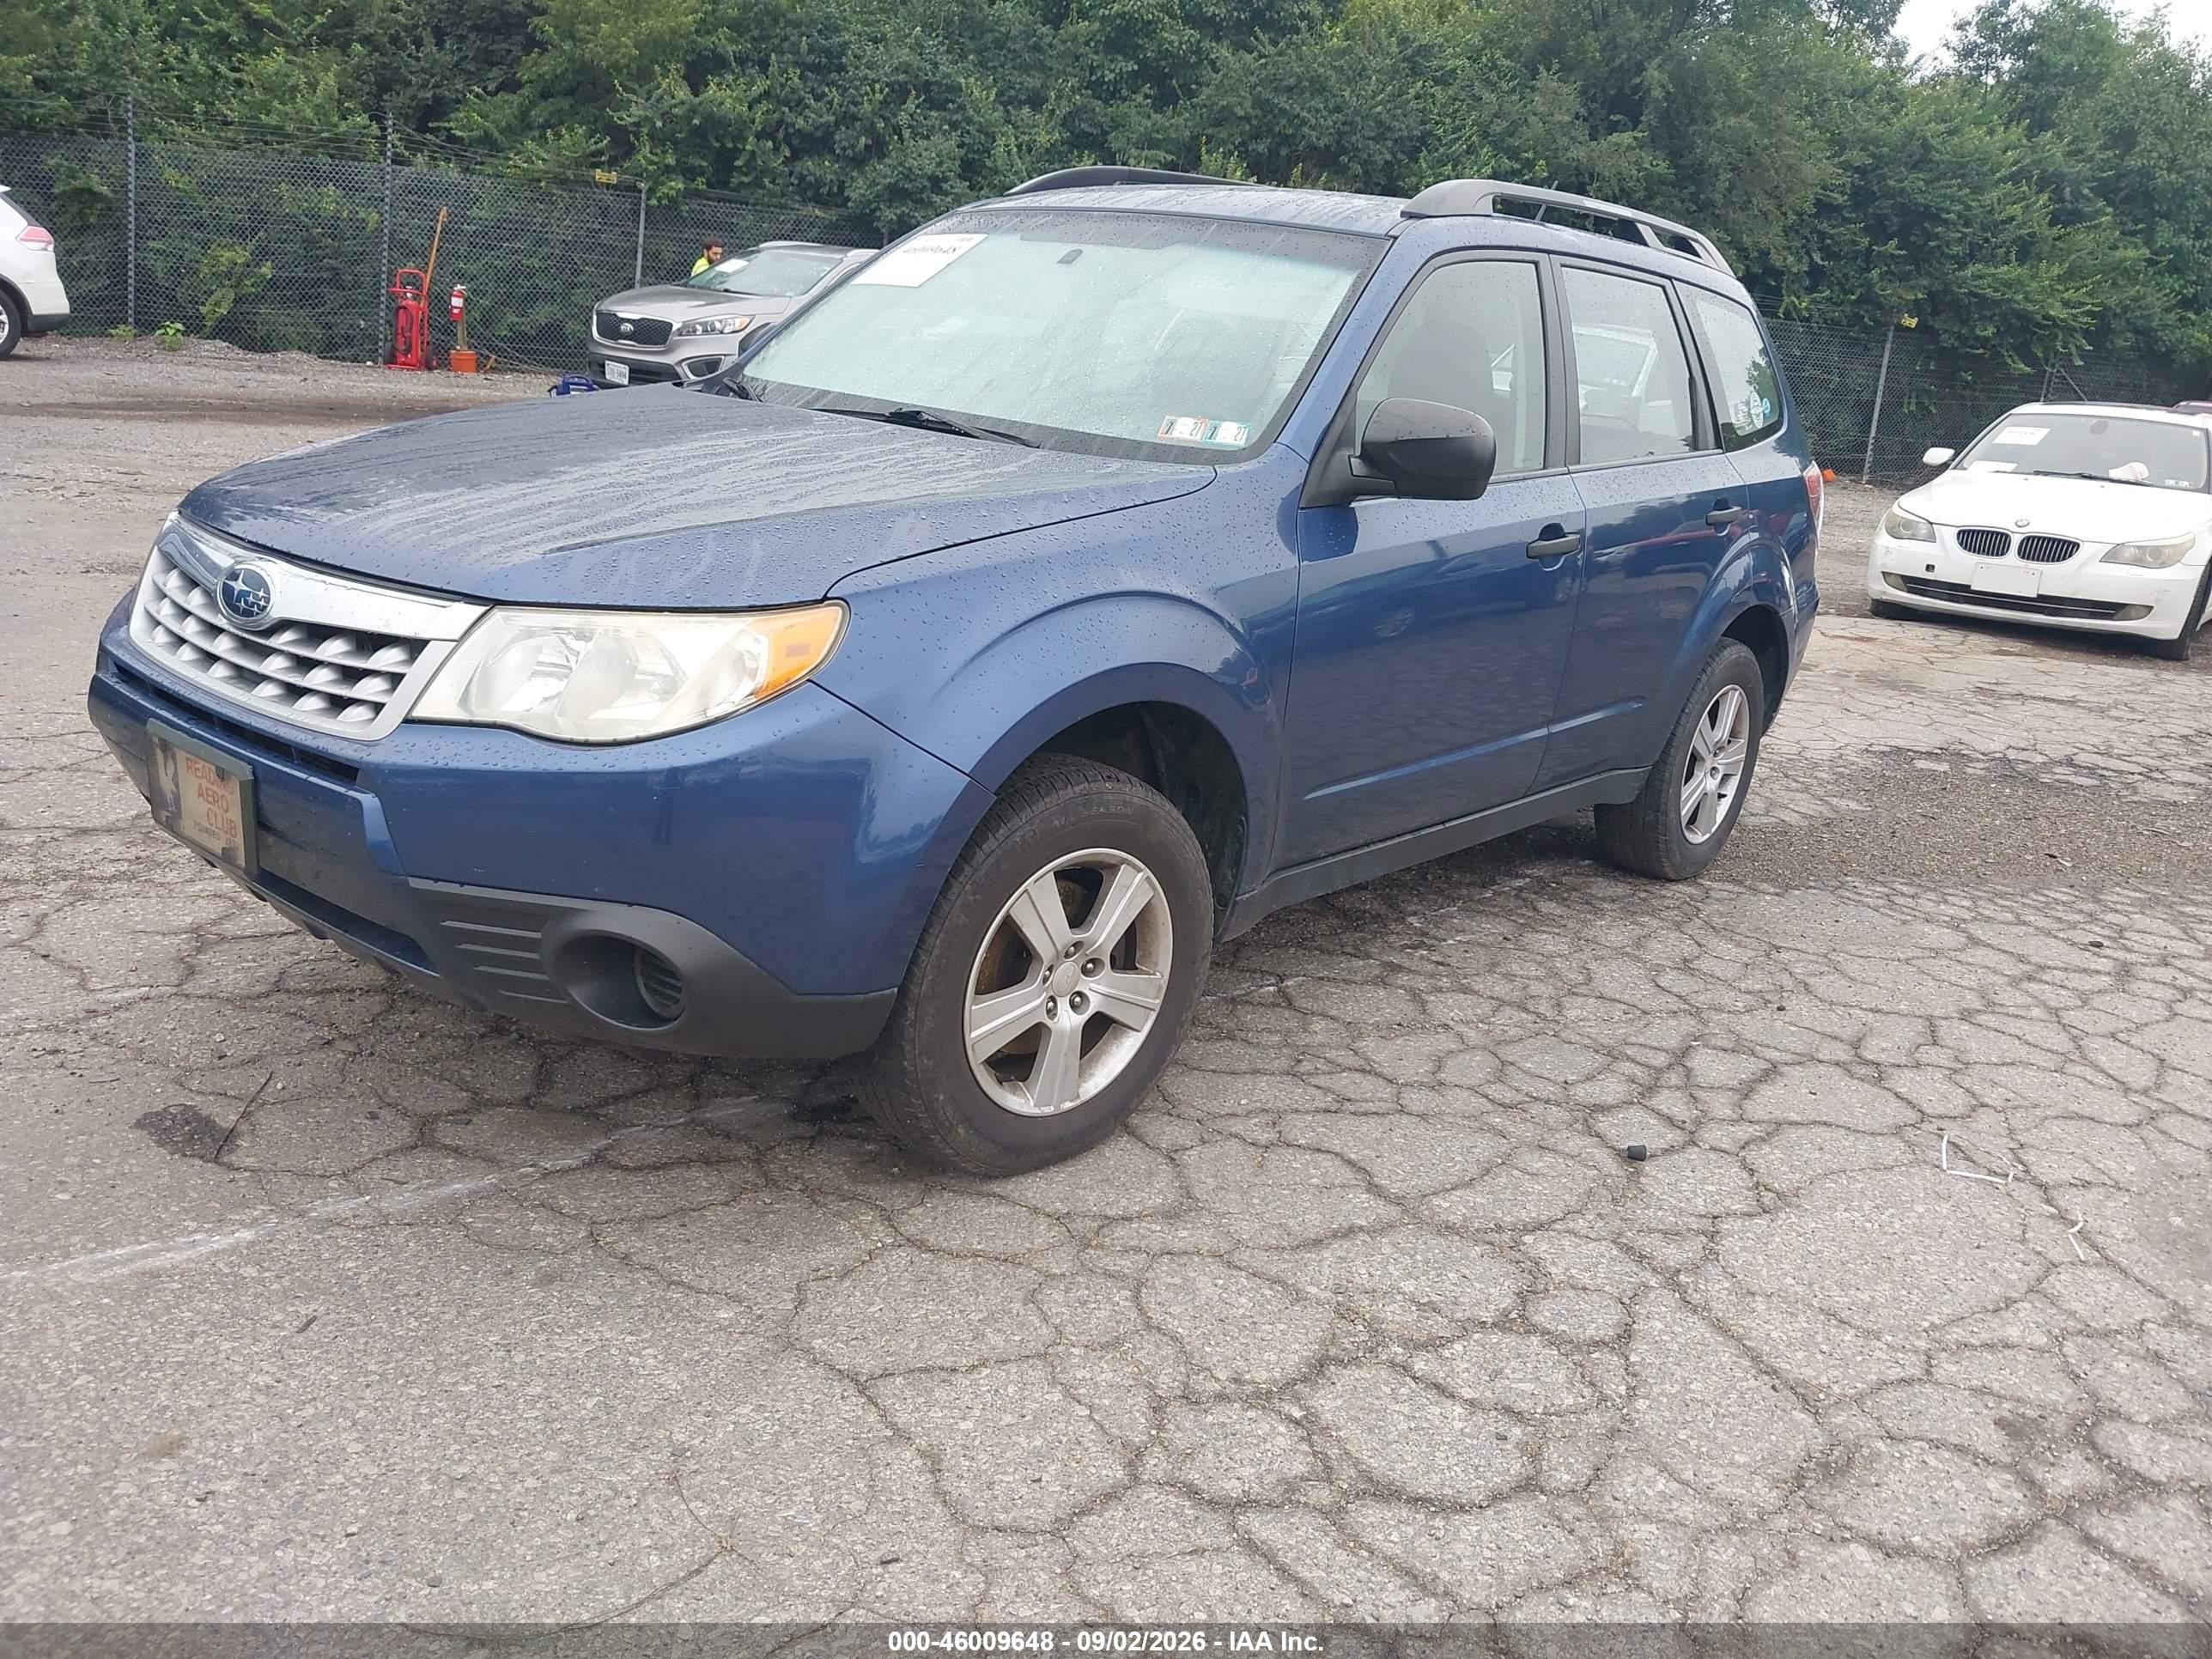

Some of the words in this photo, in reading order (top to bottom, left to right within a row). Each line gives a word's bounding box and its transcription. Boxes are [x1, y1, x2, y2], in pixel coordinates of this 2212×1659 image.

[1190, 422, 1203, 437] 27
[1234, 426, 1248, 442] 27
[197, 782, 229, 813] AERO
[206, 807, 238, 839] CLUB
